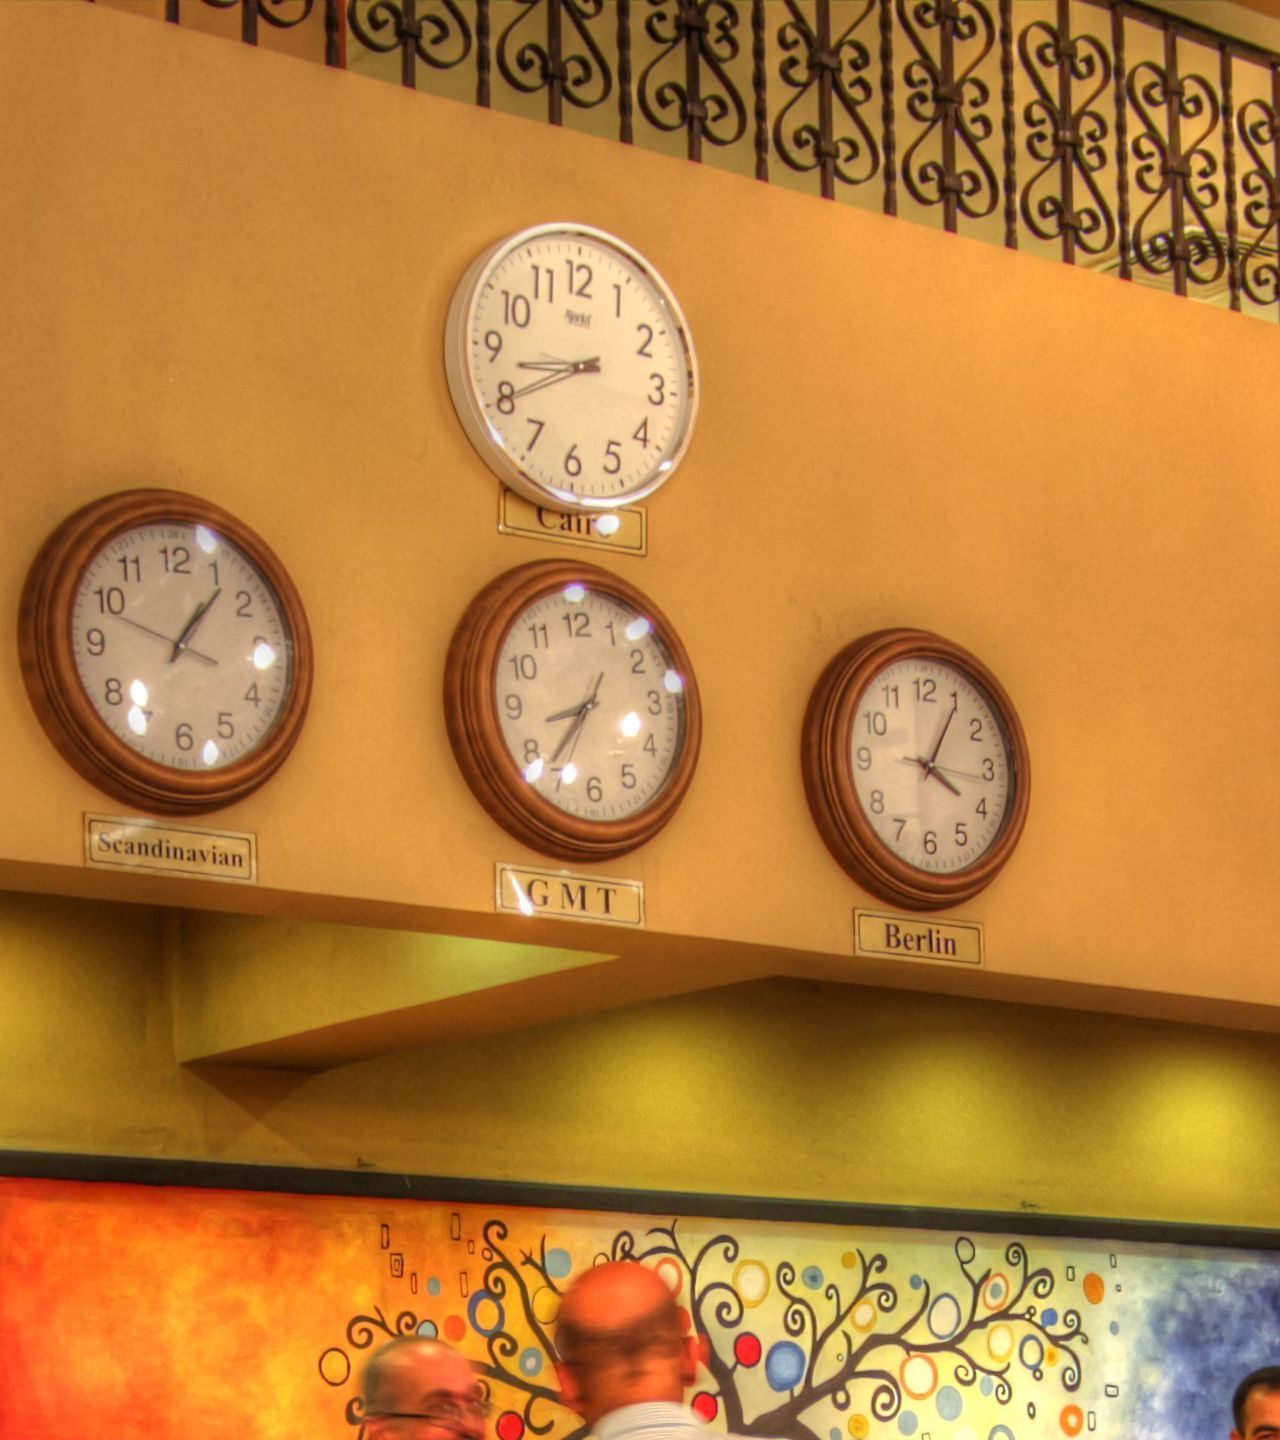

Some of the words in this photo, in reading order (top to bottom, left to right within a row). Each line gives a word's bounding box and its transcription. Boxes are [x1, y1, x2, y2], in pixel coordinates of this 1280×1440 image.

[531, 265, 553, 303] 11
[565, 259, 593, 298] 12
[501, 290, 531, 328] 10
[613, 284, 621, 317] 1
[485, 330, 502, 363] 9
[636, 324, 653, 358] 2
[496, 381, 515, 415] 8
[647, 373, 665, 405] 3
[527, 418, 545, 451] 7
[633, 416, 650, 449] 4
[564, 444, 582, 476] 6
[603, 440, 621, 474] 5
[536, 507, 613, 537] Cair
[118, 555, 141, 582] 11
[159, 546, 191, 574] 12
[209, 560, 219, 586] 1
[94, 587, 125, 615] 10
[236, 591, 253, 617] 2
[528, 624, 548, 649] 11
[562, 613, 591, 638] 12
[606, 622, 616, 647] 1
[86, 628, 105, 656] 9
[509, 654, 537, 680] 10
[630, 650, 645, 674] 2
[105, 678, 123, 706] 8
[244, 683, 261, 708] 4
[647, 690, 662, 716] 3
[882, 685, 899, 708] 11
[913, 678, 937, 703] 12
[505, 694, 522, 720] 9
[218, 713, 234, 739] 5
[863, 711, 887, 736] 10
[970, 718, 983, 742] 2
[175, 723, 194, 751] 6
[643, 733, 658, 758] 4
[857, 746, 871, 771] 9
[982, 758, 995, 782] 3
[586, 777, 602, 802] 6
[621, 764, 636, 789] 5
[870, 789, 884, 814] 8
[976, 798, 987, 820] 4
[893, 818, 906, 842] 7
[924, 831, 937, 855] 6
[955, 823, 968, 846] 5
[97, 831, 244, 868] Scandinavian
[885, 923, 957, 955] Berlin
